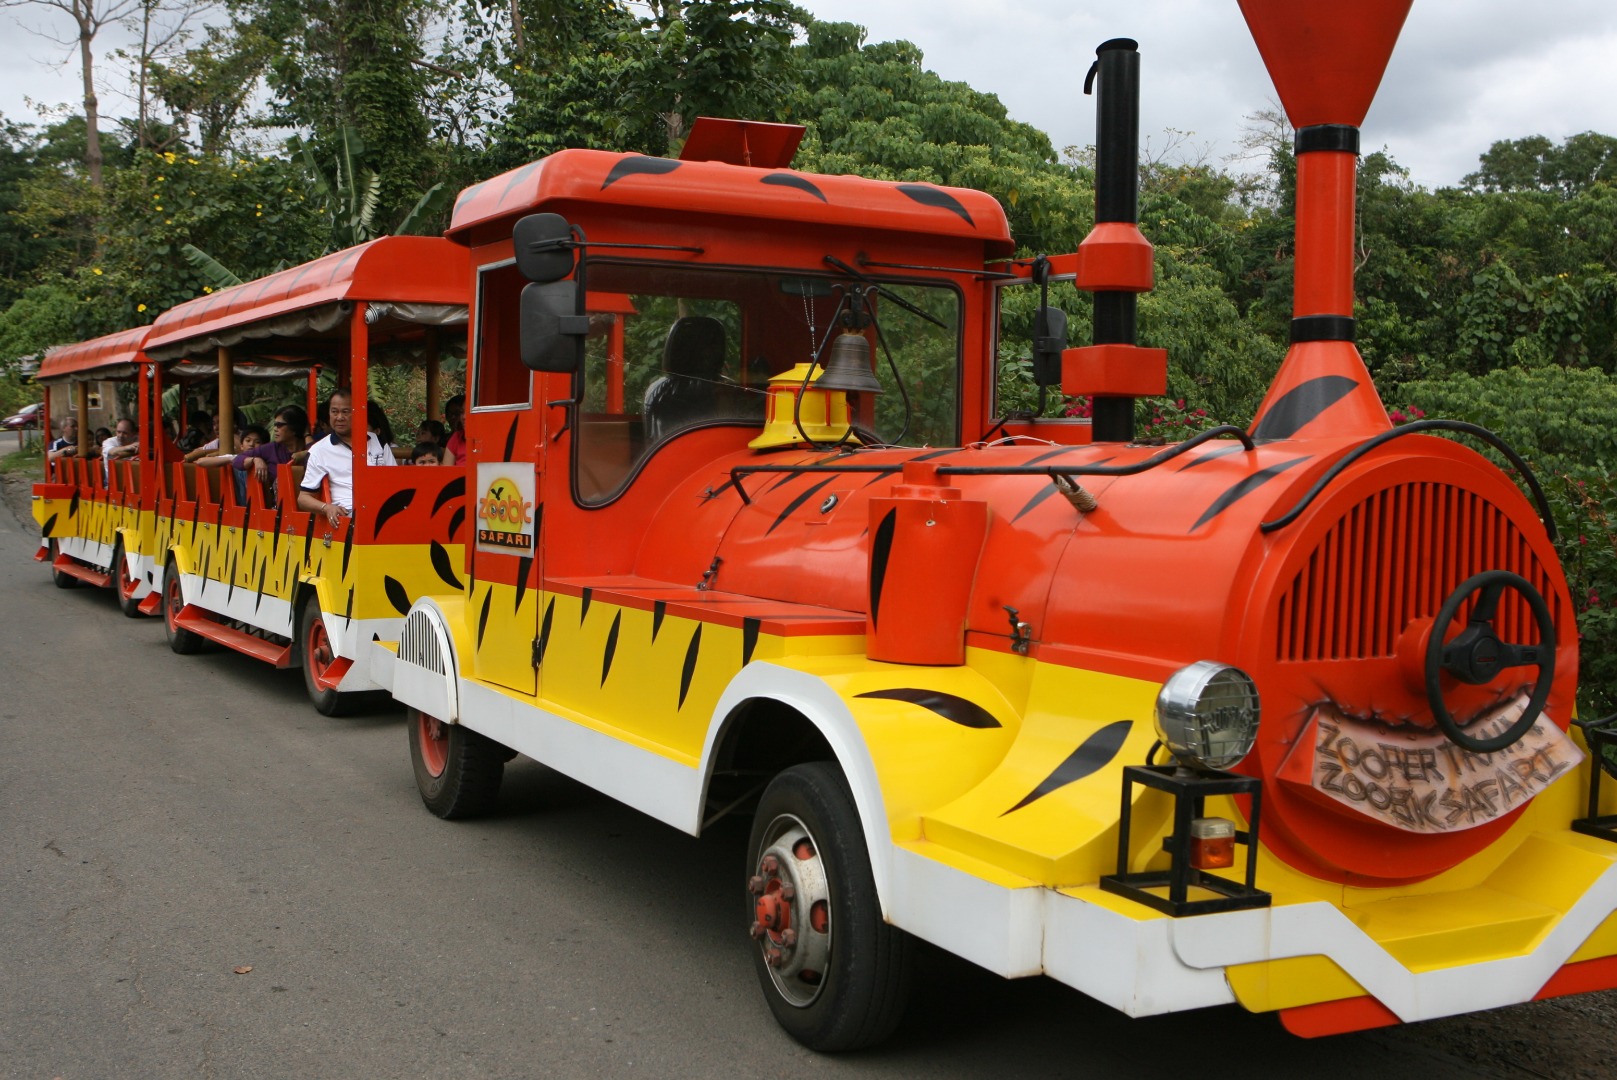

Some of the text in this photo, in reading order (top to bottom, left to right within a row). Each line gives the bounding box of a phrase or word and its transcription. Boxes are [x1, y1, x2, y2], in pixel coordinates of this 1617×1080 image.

[480, 530, 529, 546] SAFARI
[1316, 721, 1445, 783] ZOOPER
[1439, 742, 1570, 824] SAFARI
